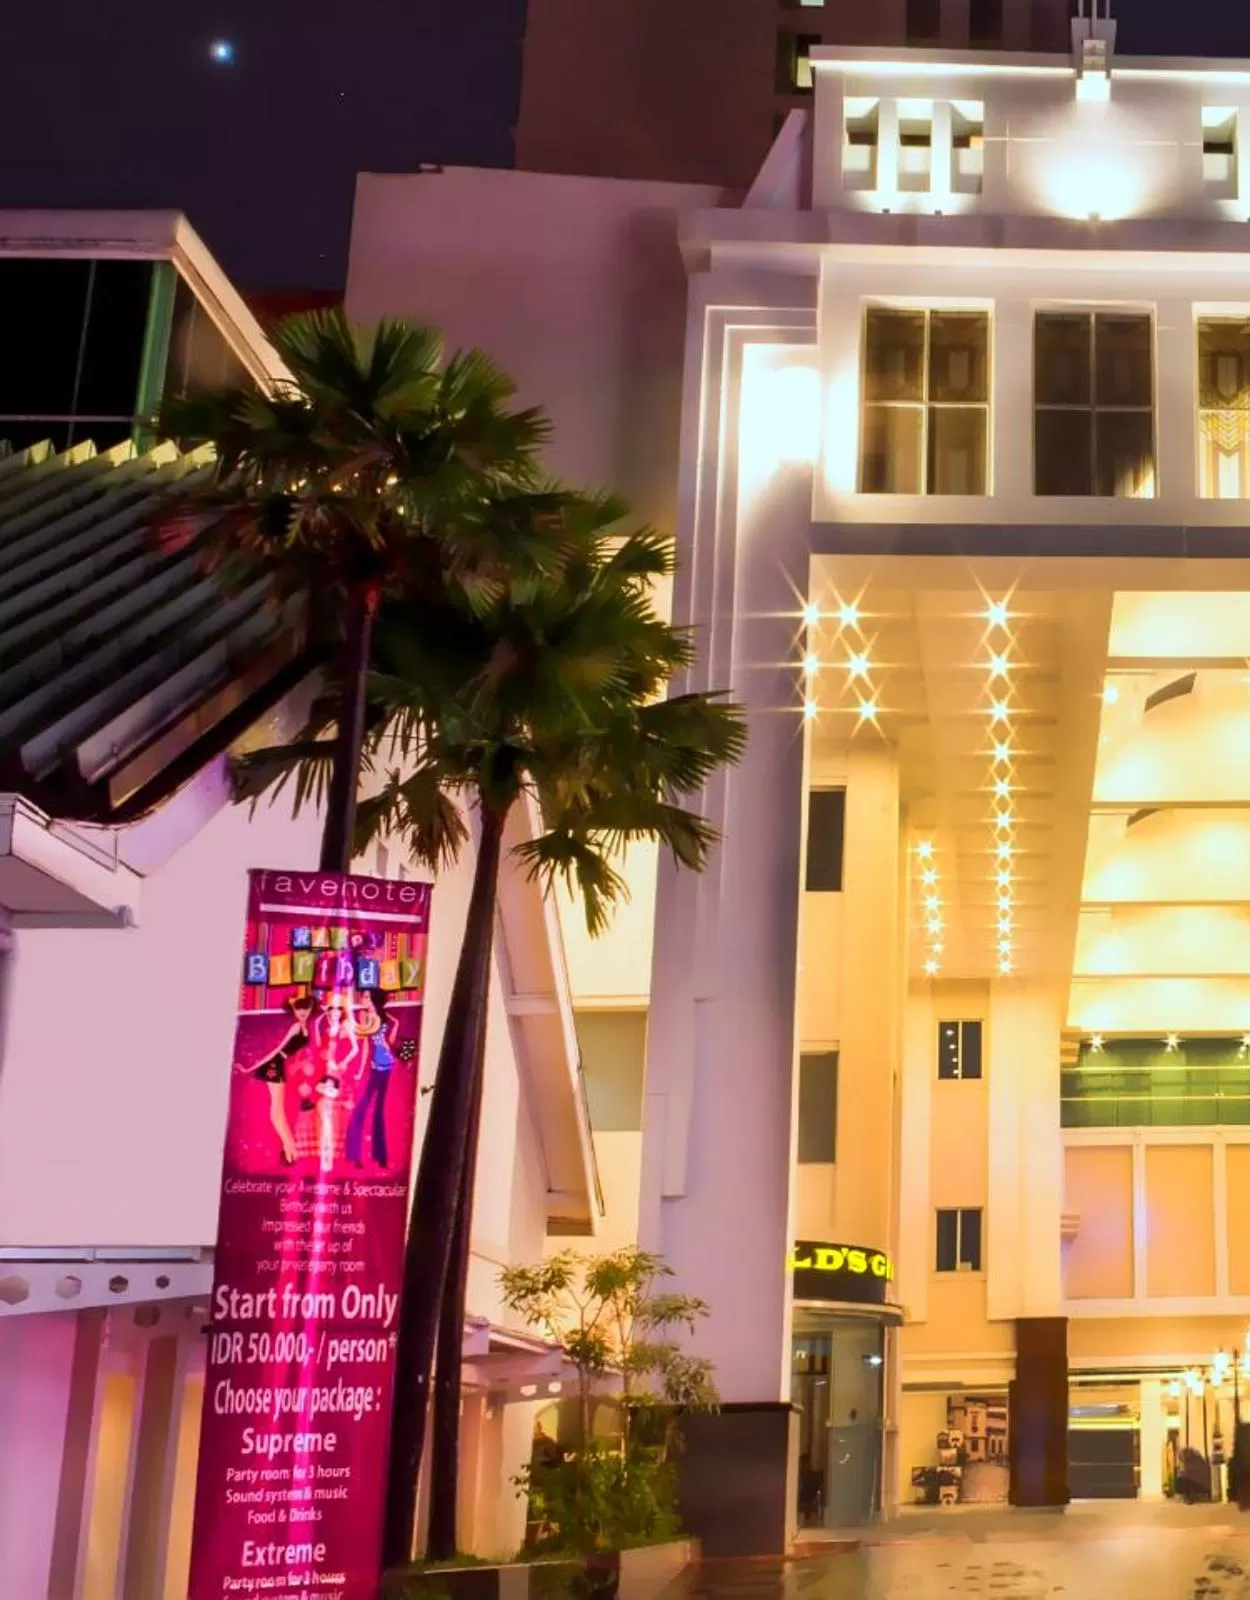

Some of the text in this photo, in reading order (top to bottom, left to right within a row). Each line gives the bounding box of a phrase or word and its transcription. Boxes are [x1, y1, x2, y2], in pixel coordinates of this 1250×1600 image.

[257, 868, 426, 903] favehotel
[248, 953, 421, 985] Birthday
[224, 1179, 272, 1195] Celebrate
[352, 1181, 408, 1198] Spectacular
[339, 1261, 366, 1273] room
[214, 1282, 399, 1328] Start from Only
[211, 1332, 244, 1365] IDR
[214, 1378, 271, 1415] Choose
[272, 1387, 307, 1421] your
[241, 1427, 337, 1460] Supreme
[226, 1464, 351, 1484] Party room for 3 hours
[226, 1488, 264, 1504] Sound
[264, 1489, 301, 1504] system
[314, 1484, 348, 1500] music
[247, 1506, 323, 1525] Food & Drinks
[241, 1540, 327, 1567] Extreme
[223, 1576, 254, 1592] Party
[255, 1575, 286, 1589] room
[288, 1570, 302, 1586] for
[311, 1569, 346, 1585] hours
